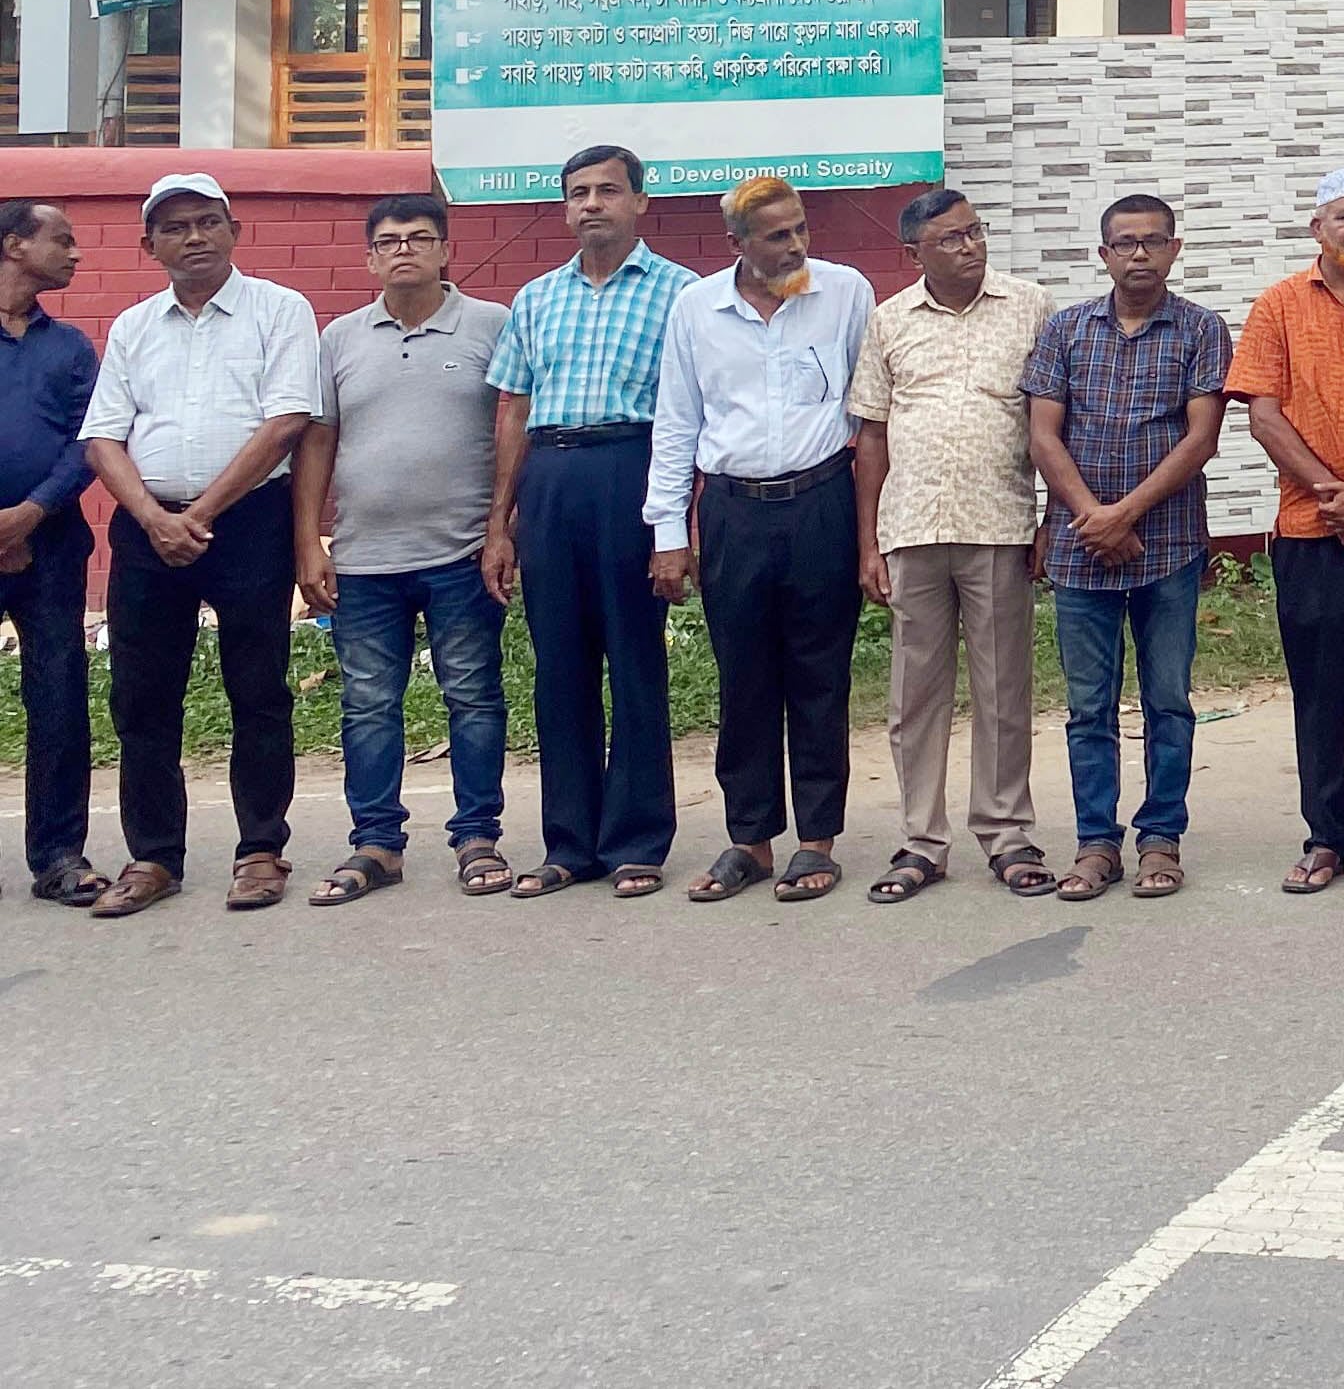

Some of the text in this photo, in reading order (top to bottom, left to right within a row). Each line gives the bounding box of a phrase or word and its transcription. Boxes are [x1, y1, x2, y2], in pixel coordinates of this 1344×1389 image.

[501, 16, 920, 50] পাহাড় গাছ কাটা ও বন্যপ্রাণী হত্যা, নিজ পায়ে কুড়াল মারা এক কথা
[500, 58, 537, 86] সবাই
[541, 61, 585, 87] পাহাড়
[588, 61, 614, 84] গাছ
[617, 57, 648, 82] কাটা
[651, 60, 674, 81] বন্ধ
[677, 53, 709, 84] করি,
[712, 52, 768, 87] প্রাকৃতিক
[772, 50, 823, 78] পরিবেশ
[826, 56, 854, 76] রক্ষা
[479, 171, 516, 191] Hill
[647, 168, 661, 185] &
[670, 163, 812, 184] Development
[817, 160, 893, 181] Socaity
